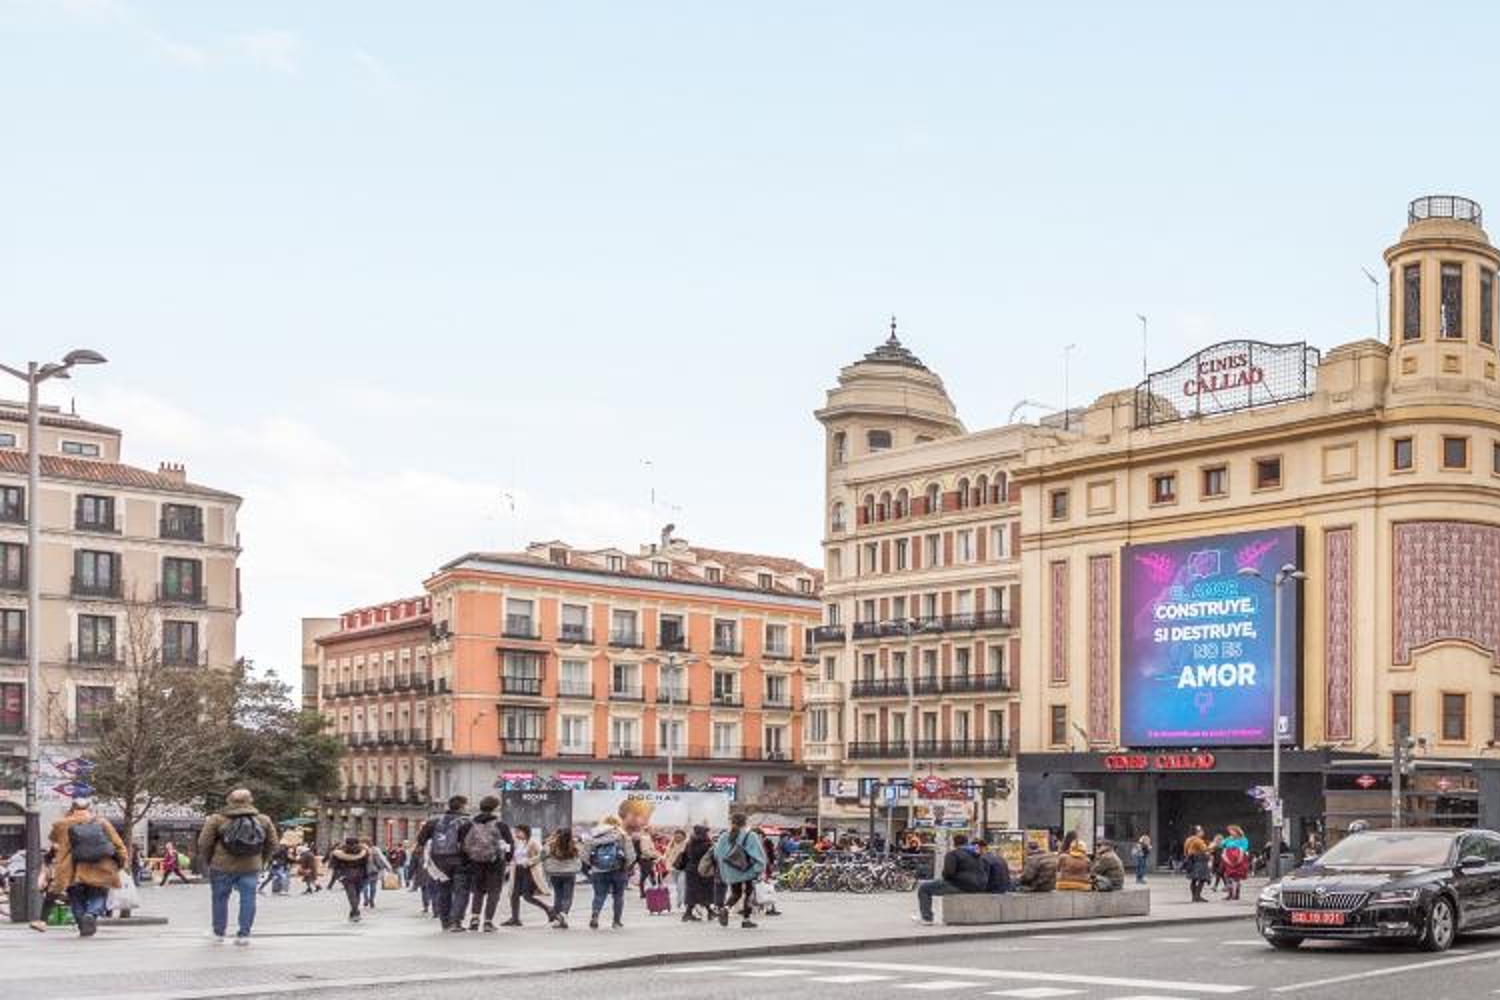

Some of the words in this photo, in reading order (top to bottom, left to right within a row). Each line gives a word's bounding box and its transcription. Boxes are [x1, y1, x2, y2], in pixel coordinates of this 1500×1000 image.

[1199, 353, 1248, 375] CINES
[1183, 367, 1264, 397] CALLAO
[1154, 627, 1169, 642] SI
[1171, 621, 1257, 642] DESTRUYE,
[1177, 663, 1256, 689] AMOR
[1153, 753, 1216, 770] CALLAO
